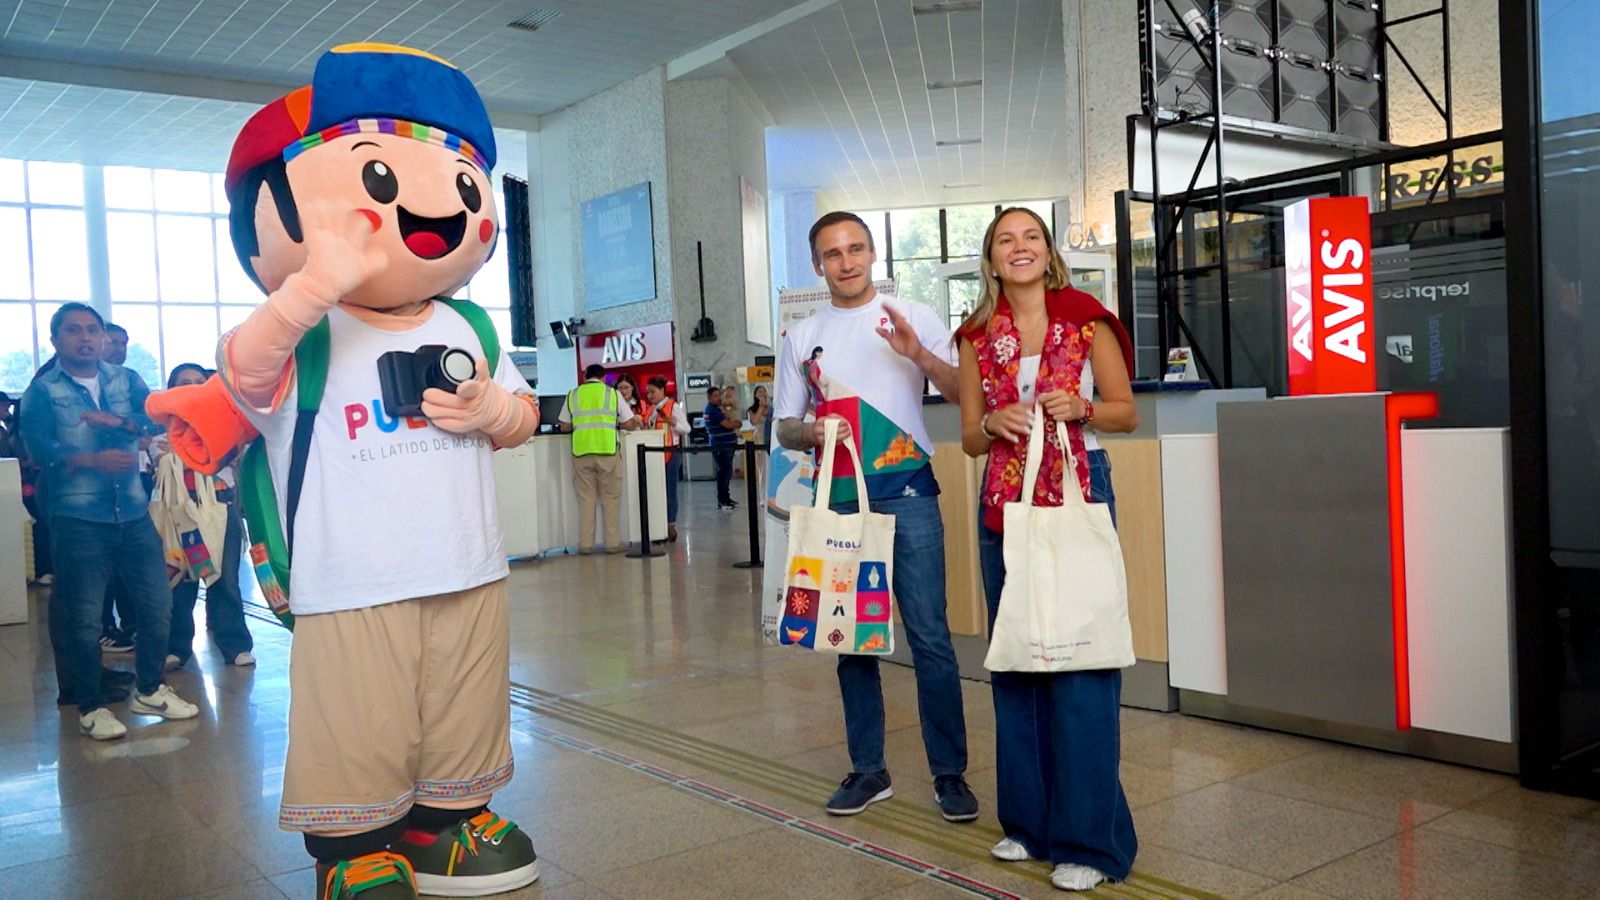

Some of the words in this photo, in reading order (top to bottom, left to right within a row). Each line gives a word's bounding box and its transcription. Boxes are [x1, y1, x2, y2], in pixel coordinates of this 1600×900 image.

[1321, 238, 1367, 363] AVIS
[602, 332, 645, 364] AVIS
[359, 449, 376, 462] EL
[380, 440, 428, 458] LATIDO
[433, 437, 448, 450] DE
